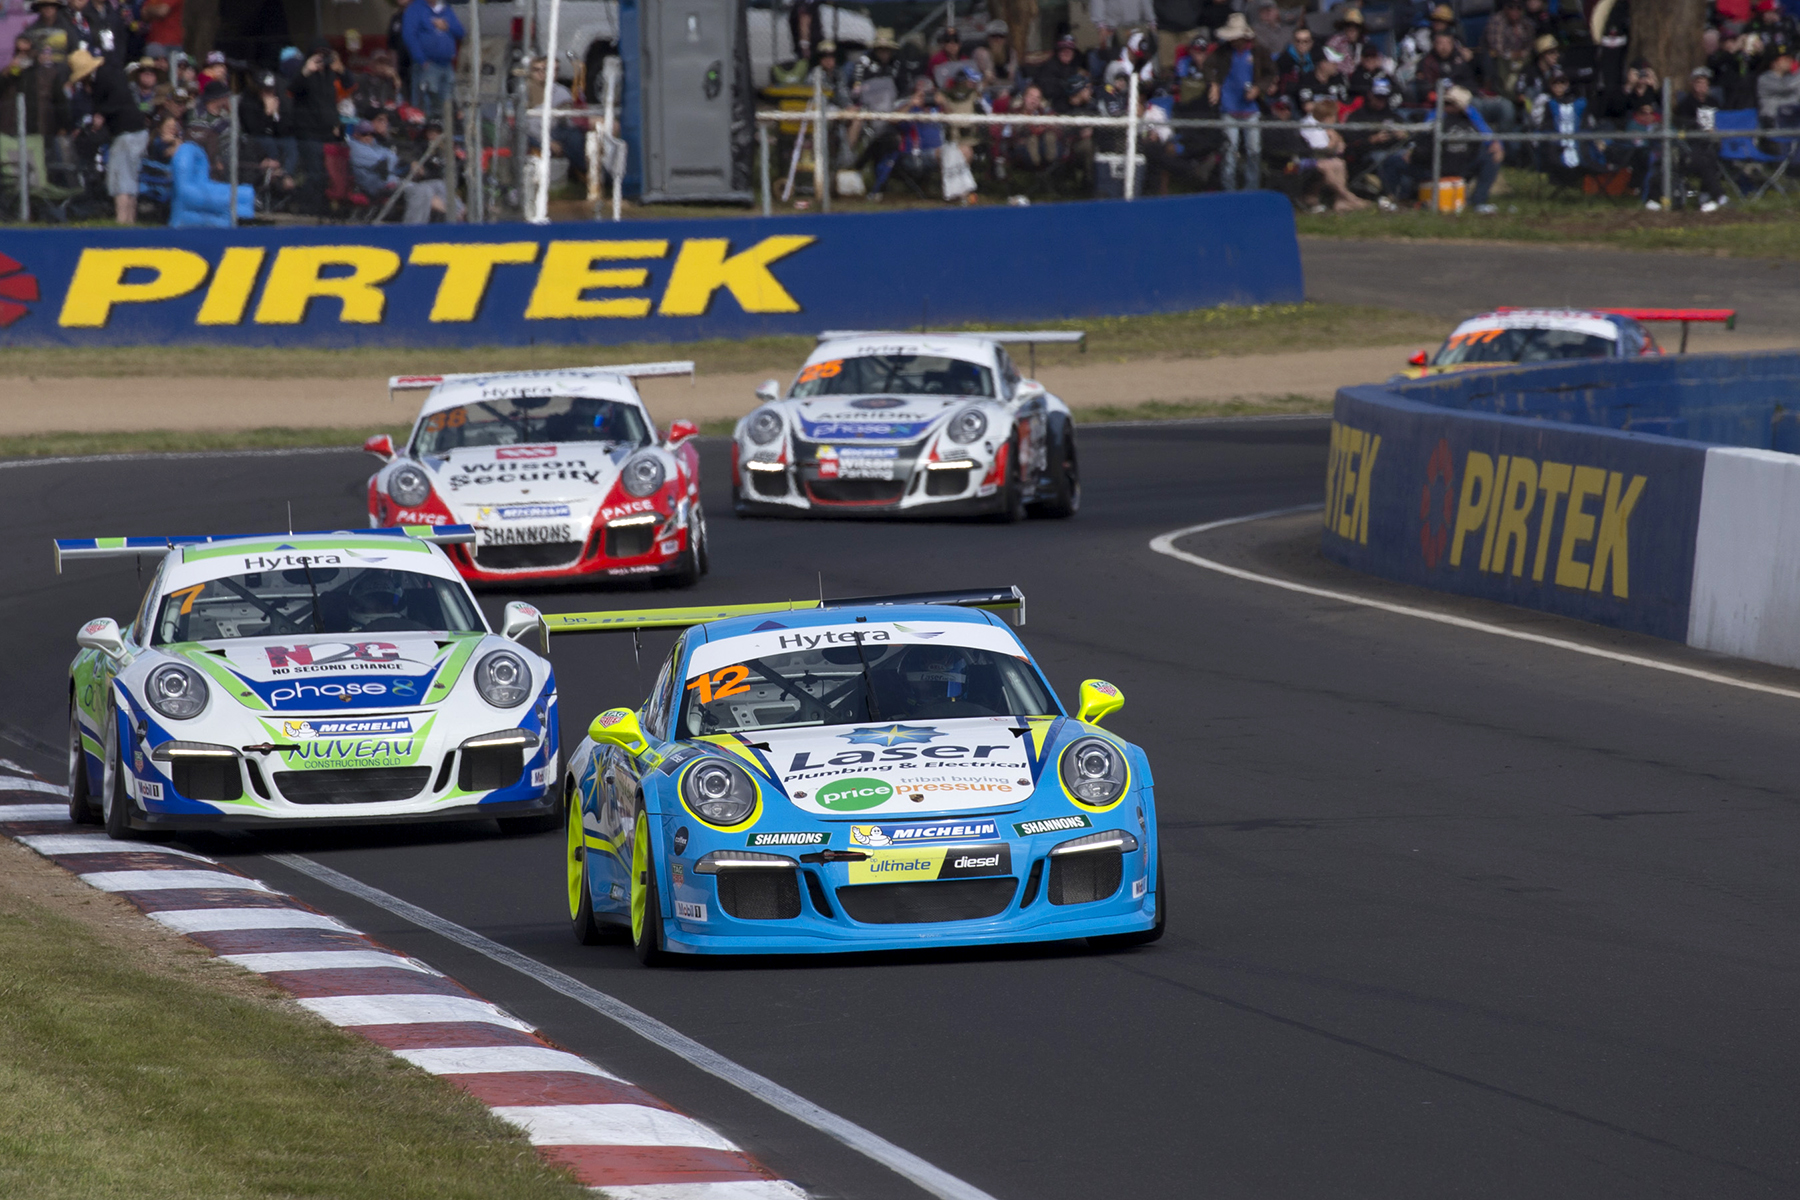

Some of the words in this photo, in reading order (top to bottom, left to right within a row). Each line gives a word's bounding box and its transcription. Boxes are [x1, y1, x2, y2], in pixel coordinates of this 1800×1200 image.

[58, 235, 816, 327] PIRTEK
[462, 460, 588, 473] Wilson
[449, 470, 602, 487] Security
[1324, 420, 1382, 546] RTEK
[396, 510, 447, 526] PAYCE
[602, 499, 655, 520] PAYCE
[1449, 450, 1648, 599] PIRTEK
[483, 523, 572, 545] SHANNONS
[244, 554, 341, 571] Hytera
[171, 583, 205, 615] 7
[779, 629, 890, 649] Hytera
[272, 668, 290, 676] NO
[294, 665, 347, 673] SECOND
[351, 662, 403, 671] CHANCE
[687, 665, 751, 704] 12
[271, 682, 387, 707] phase
[318, 720, 409, 732] MICHELIN
[288, 737, 414, 761] NUVEAU
[304, 758, 379, 769] CONSTRUCTIONS
[382, 757, 401, 766] QLD
[789, 744, 1011, 772] Laser
[783, 763, 893, 783] Plumbing
[898, 762, 918, 770] &
[924, 760, 1028, 770] Electrical
[900, 775, 946, 784] tribal
[950, 775, 1010, 786] buying
[823, 786, 892, 805] price
[896, 783, 1013, 796] pressure
[892, 824, 995, 839] MICHELIN
[1021, 816, 1085, 834] SHANNONS
[754, 832, 823, 845] SHANNONS
[672, 865, 683, 874] TAG
[870, 859, 931, 873] ultimate
[954, 854, 1000, 869] diesel
[677, 902, 695, 918] Mobil
[694, 905, 702, 918] 1
